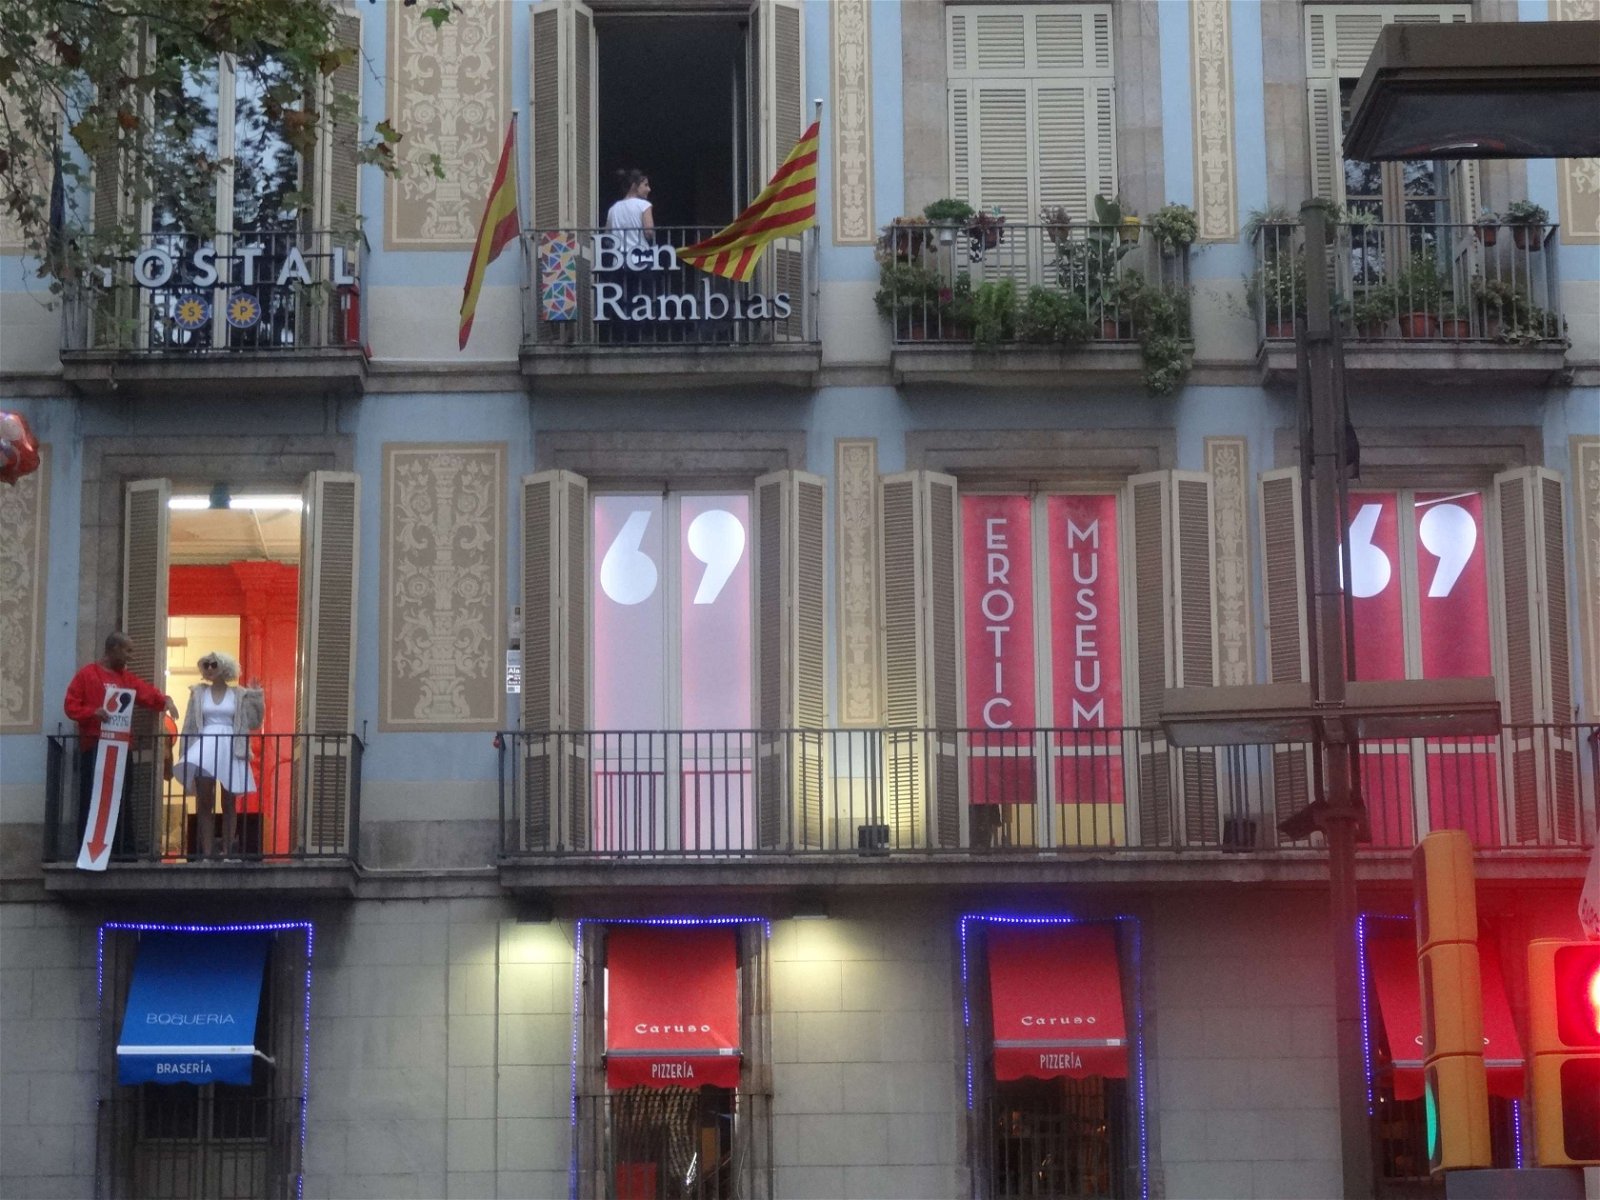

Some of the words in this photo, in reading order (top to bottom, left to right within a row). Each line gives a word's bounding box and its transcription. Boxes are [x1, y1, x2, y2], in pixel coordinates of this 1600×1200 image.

[591, 234, 681, 273] Ben
[592, 277, 793, 322] Ramblas
[600, 509, 746, 605] 69
[1338, 503, 1477, 598] 69
[981, 518, 1015, 730] EROTIC
[1067, 518, 1105, 729] MUSEUM
[106, 692, 132, 713] 69
[146, 1012, 236, 1026] BOQUERIA
[634, 1023, 712, 1035] Caruso
[1021, 1015, 1097, 1027] Caruso
[651, 1061, 695, 1079] PIZZERÍA
